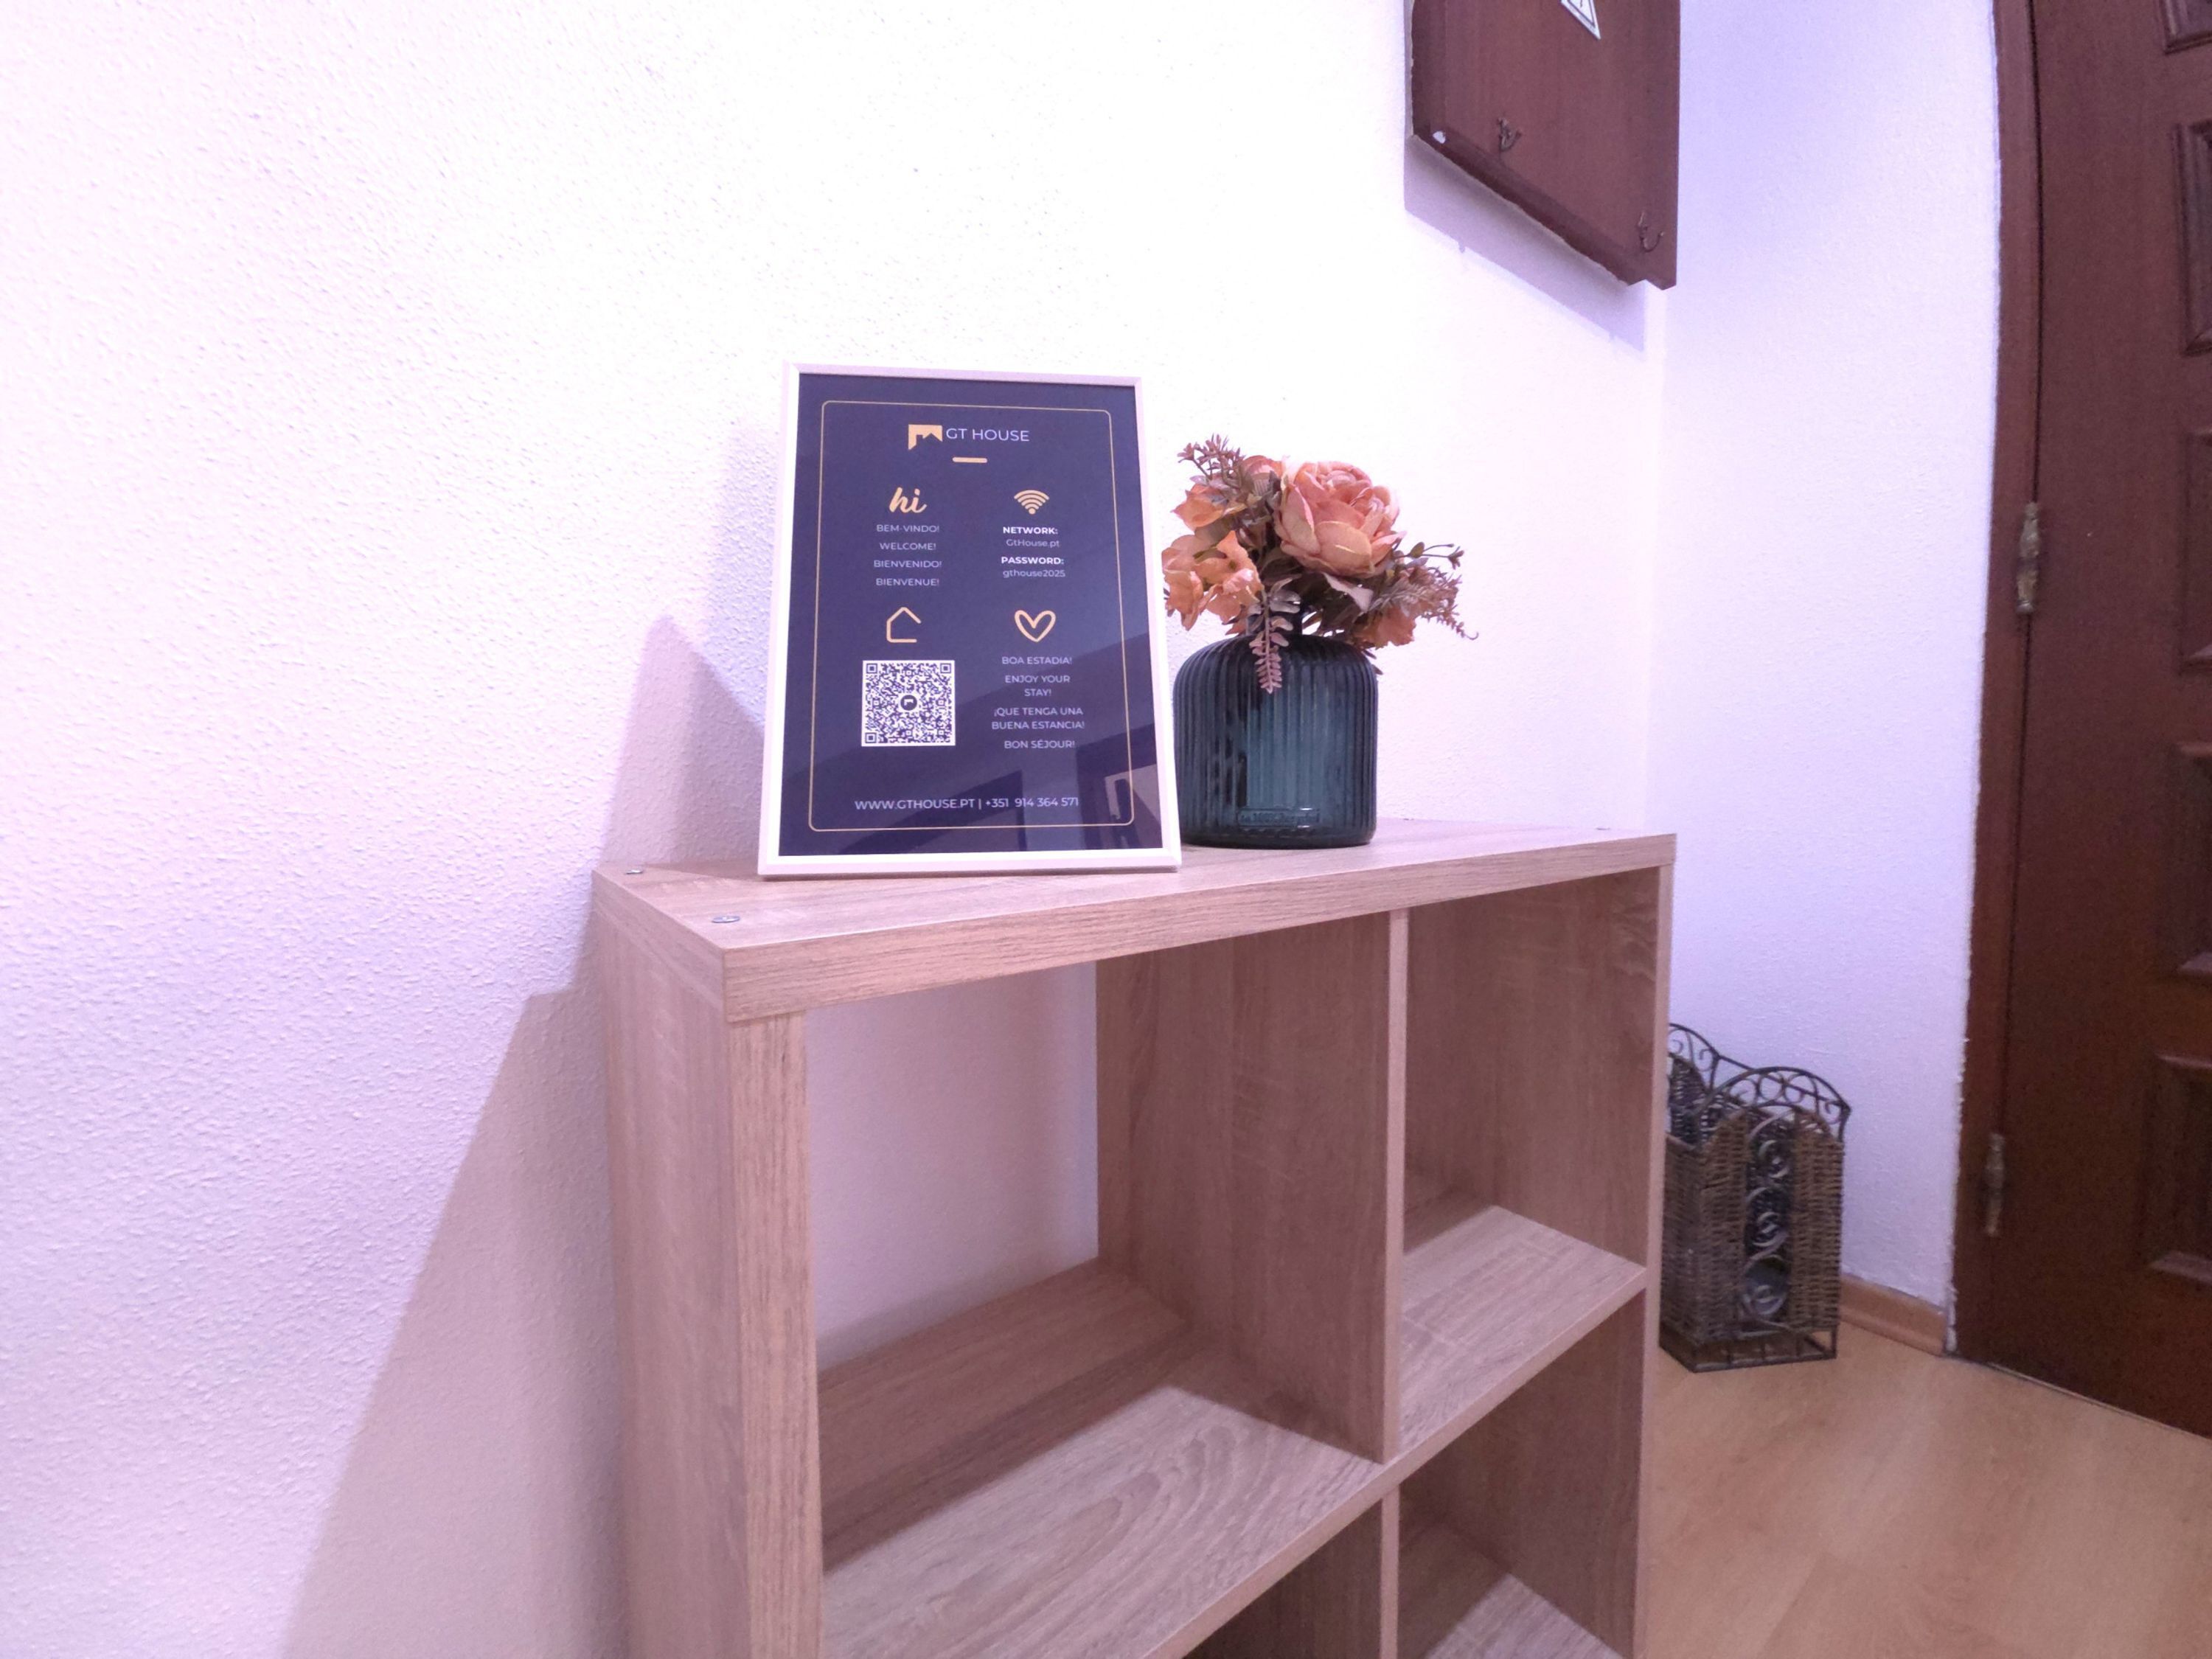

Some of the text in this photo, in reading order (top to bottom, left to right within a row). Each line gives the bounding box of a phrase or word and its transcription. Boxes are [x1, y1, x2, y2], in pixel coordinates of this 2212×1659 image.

[946, 428, 1030, 442] GT HOUSE
[888, 487, 927, 513] hi
[1003, 526, 1058, 535] NETWORK:
[879, 542, 936, 551] WELCOME!
[1006, 538, 1060, 549] GtHouse.pt
[873, 560, 942, 568] BIENVENIDO!
[1001, 556, 1064, 565] PASSWORD:
[1002, 568, 1066, 578] gthouse2025
[876, 577, 939, 586] BIENVENUE!
[1001, 656, 1025, 664] BOA
[1005, 675, 1071, 684] ENJOY YOUR
[1024, 688, 1051, 697] STAY!
[994, 707, 1084, 717] ¡QUE TENGA UNA
[992, 720, 1085, 730] BUENA ESTANCIA!
[1004, 739, 1075, 749] BON SÉJOUR!
[855, 799, 975, 810] WWW.GTHOUSE.PT
[985, 798, 1009, 808] +351
[1015, 798, 1034, 807] 914
[1037, 797, 1059, 807] 364
[1061, 796, 1079, 807] 571
